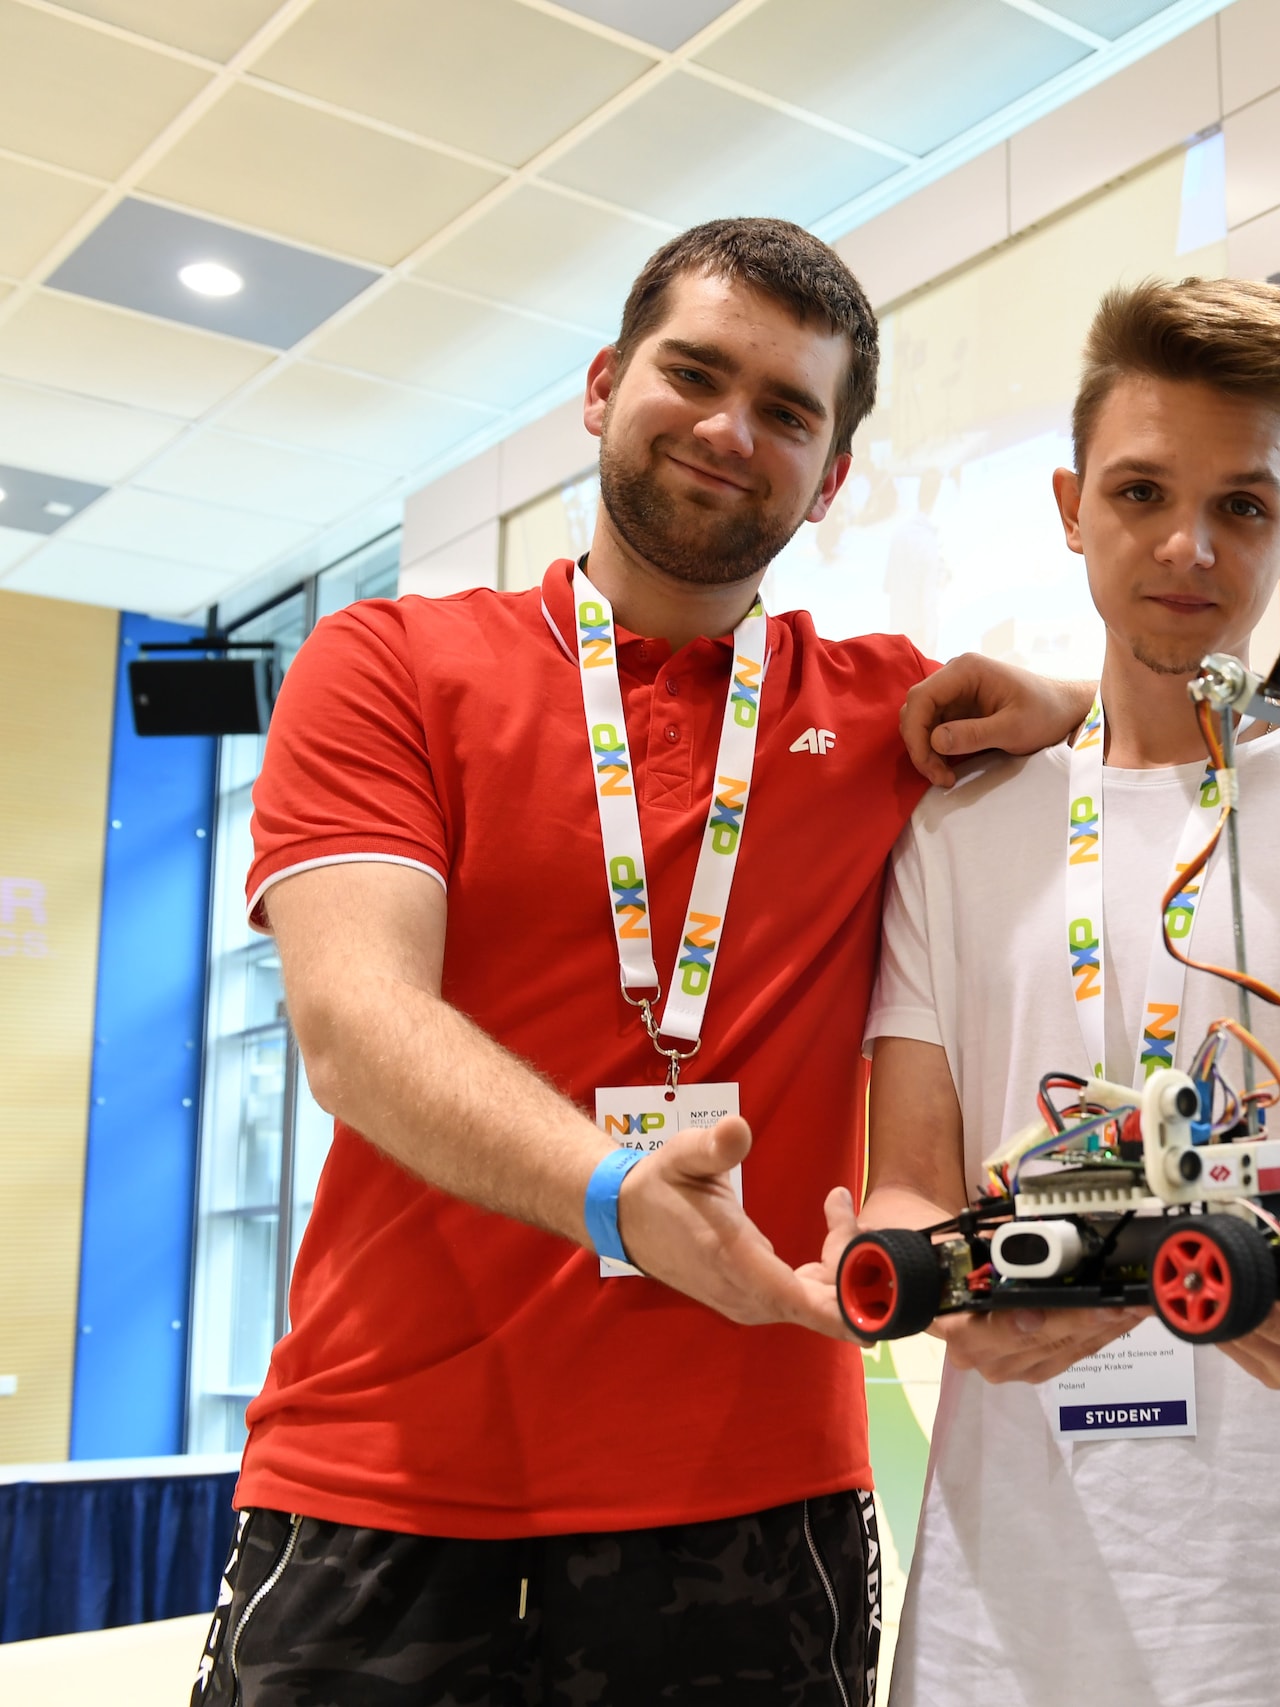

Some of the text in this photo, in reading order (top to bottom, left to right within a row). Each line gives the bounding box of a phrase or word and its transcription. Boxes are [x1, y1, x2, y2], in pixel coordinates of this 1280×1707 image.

[578, 601, 614, 669] NXP
[730, 655, 761, 729] NXP
[592, 723, 632, 796] NXP
[709, 775, 748, 856] NXP
[1069, 796, 1099, 865] NXP
[609, 856, 649, 939] NXP
[678, 911, 721, 997] NXP
[1068, 918, 1101, 1002] NXP
[604, 1112, 665, 1136] NXP
[690, 1109, 728, 1118] NXP CUP
[1058, 1382, 1085, 1390] Poland
[1065, 1363, 1133, 1373] chnology Krakow
[1159, 1348, 1174, 1356] and
[1085, 1407, 1162, 1425] STUDENT
